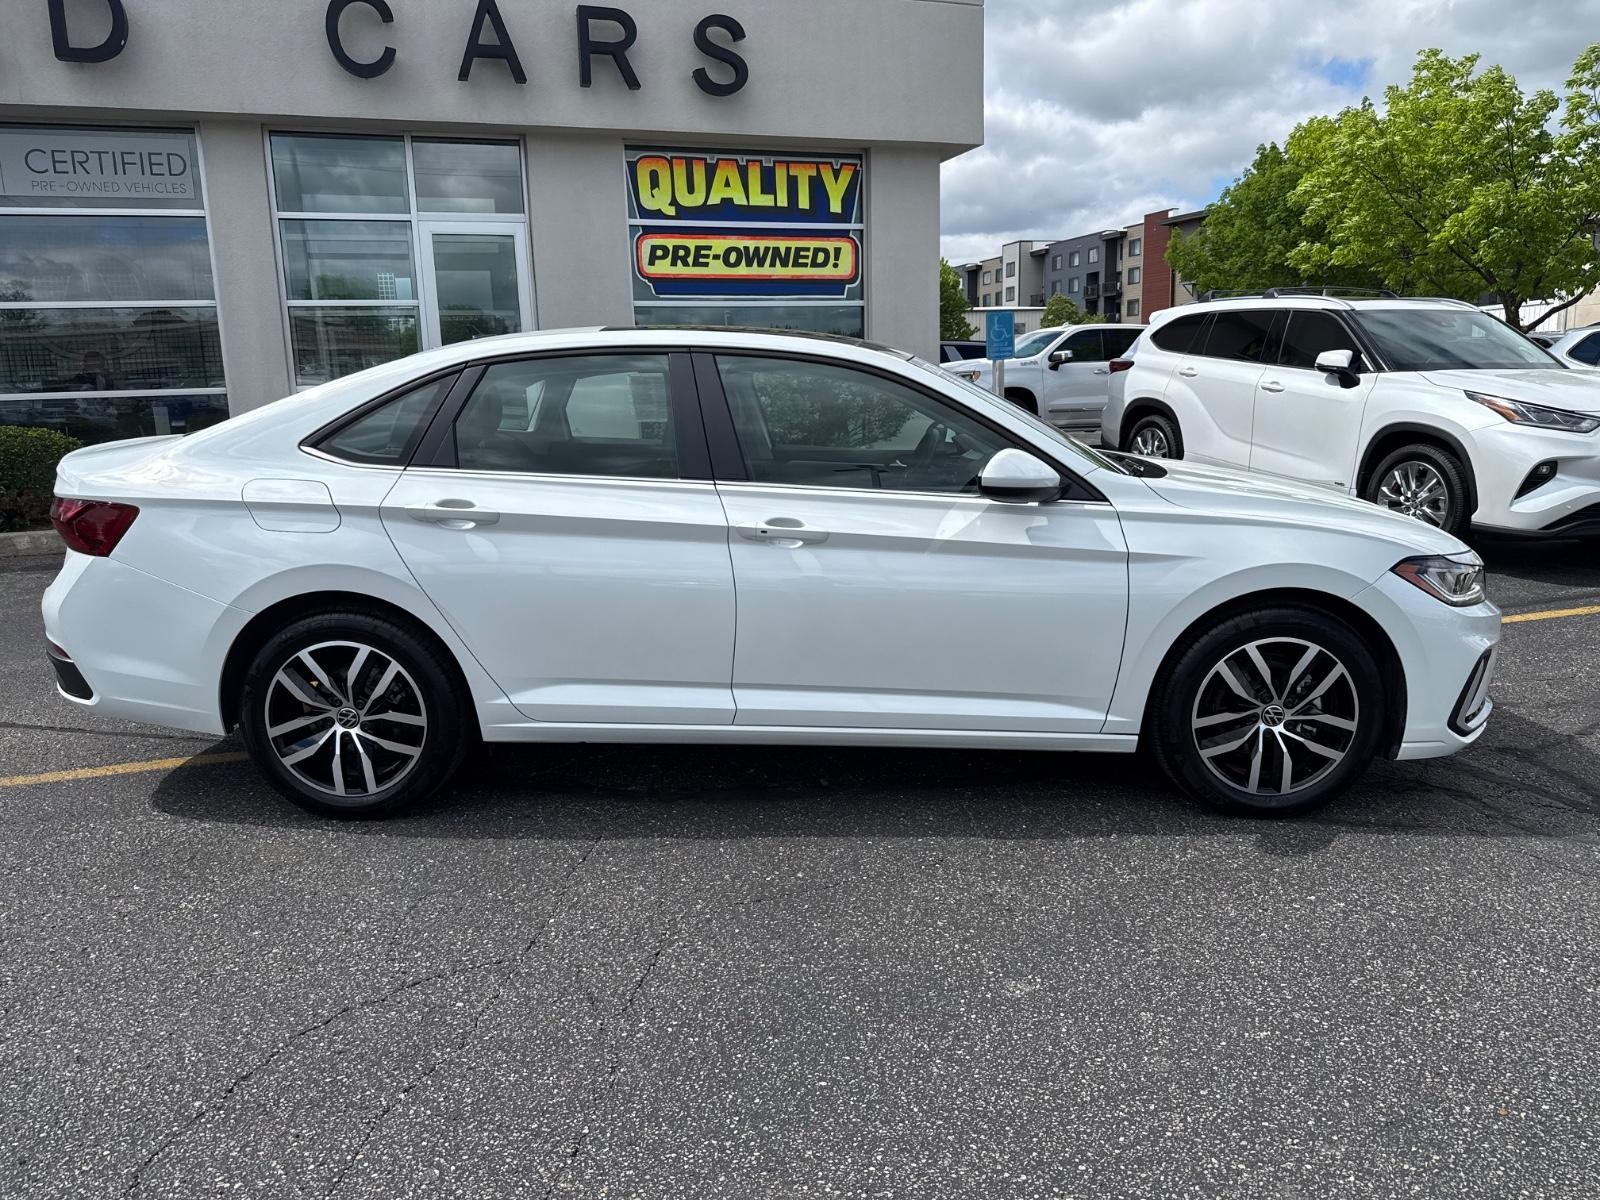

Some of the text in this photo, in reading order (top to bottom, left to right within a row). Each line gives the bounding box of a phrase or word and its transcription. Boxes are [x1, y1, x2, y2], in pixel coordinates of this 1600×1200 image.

[325, 0, 749, 97] CARS
[24, 148, 187, 177] CERTIFIED
[31, 180, 187, 194] PRE-OWNED VEHICLES
[635, 156, 857, 217] QUALITY
[647, 244, 842, 269] PRE-OWNED!
